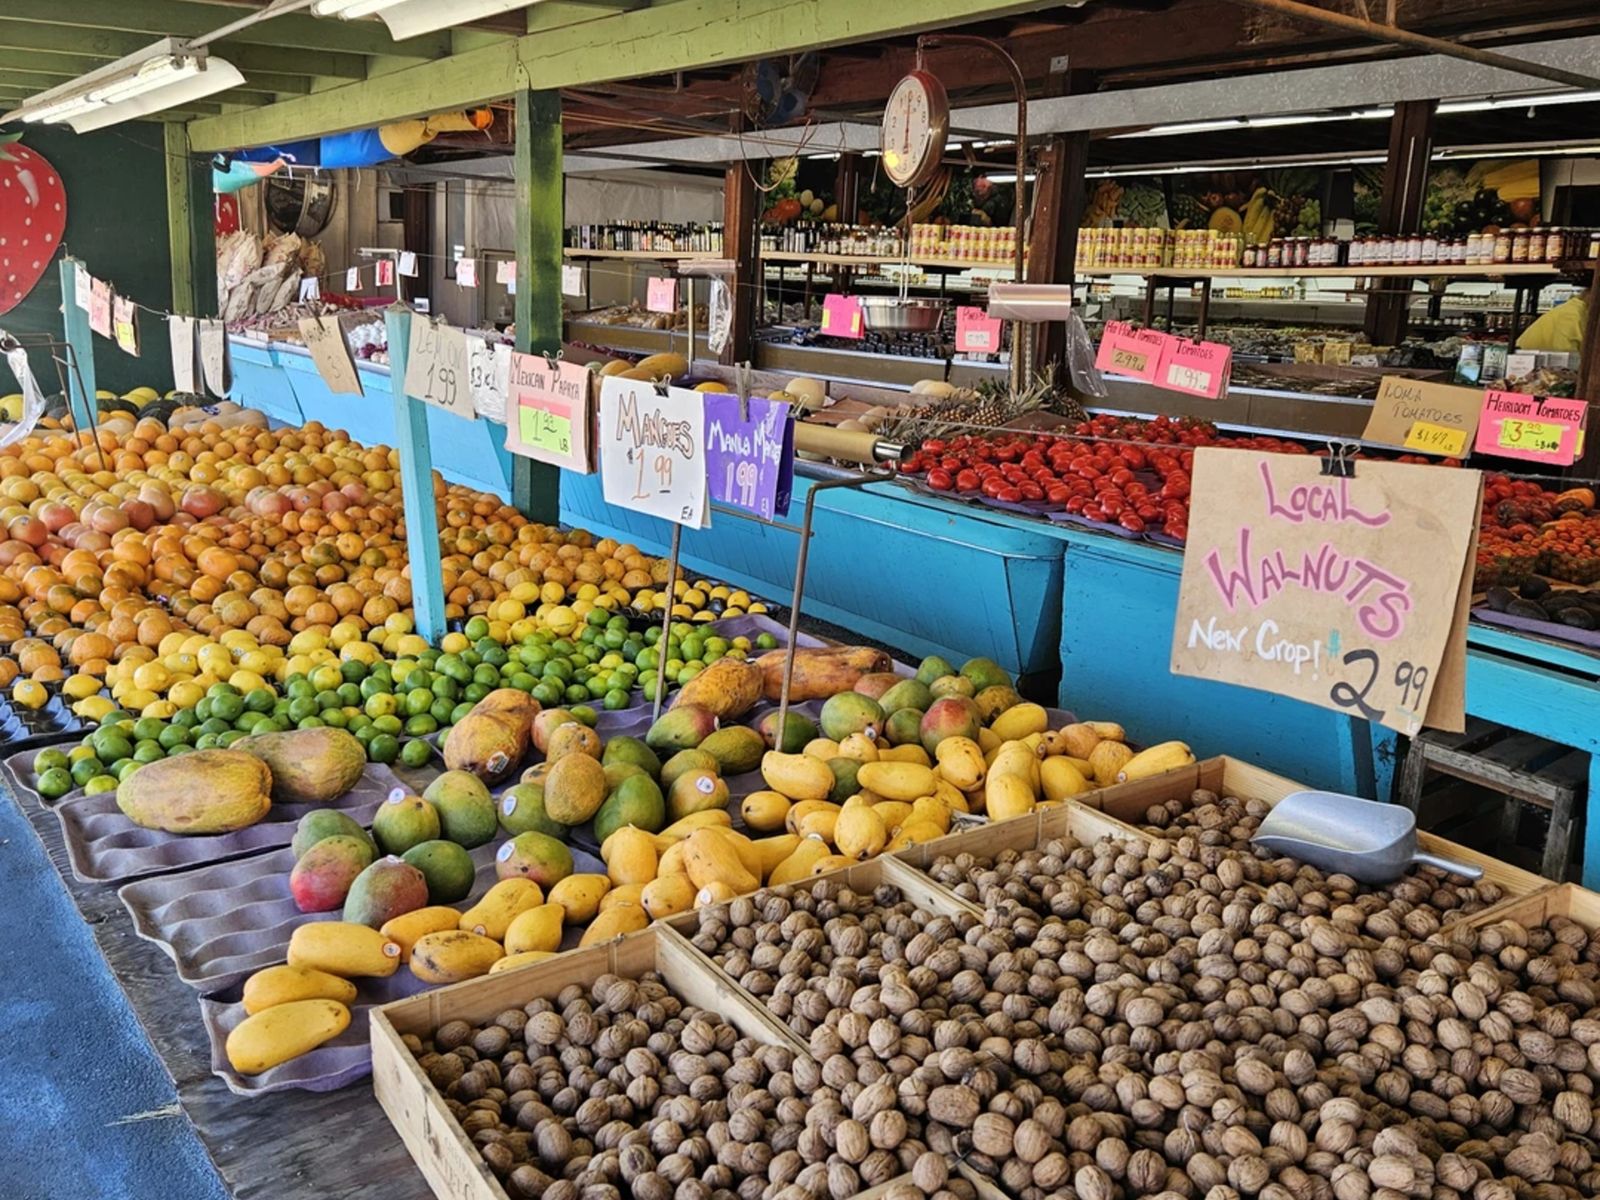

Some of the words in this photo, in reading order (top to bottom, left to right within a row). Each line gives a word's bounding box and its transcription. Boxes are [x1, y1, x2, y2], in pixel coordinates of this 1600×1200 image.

[1175, 337, 1214, 359] TOMATOES
[511, 355, 545, 390] MEXICAN
[551, 369, 581, 401] PAPAYA
[1486, 393, 1531, 415] HEIRLOOM
[1533, 396, 1581, 421] TOMATOES
[1259, 460, 1391, 528] LOCAL
[1205, 526, 1411, 639] WALNUTS
[1255, 619, 1321, 681] Crop!
